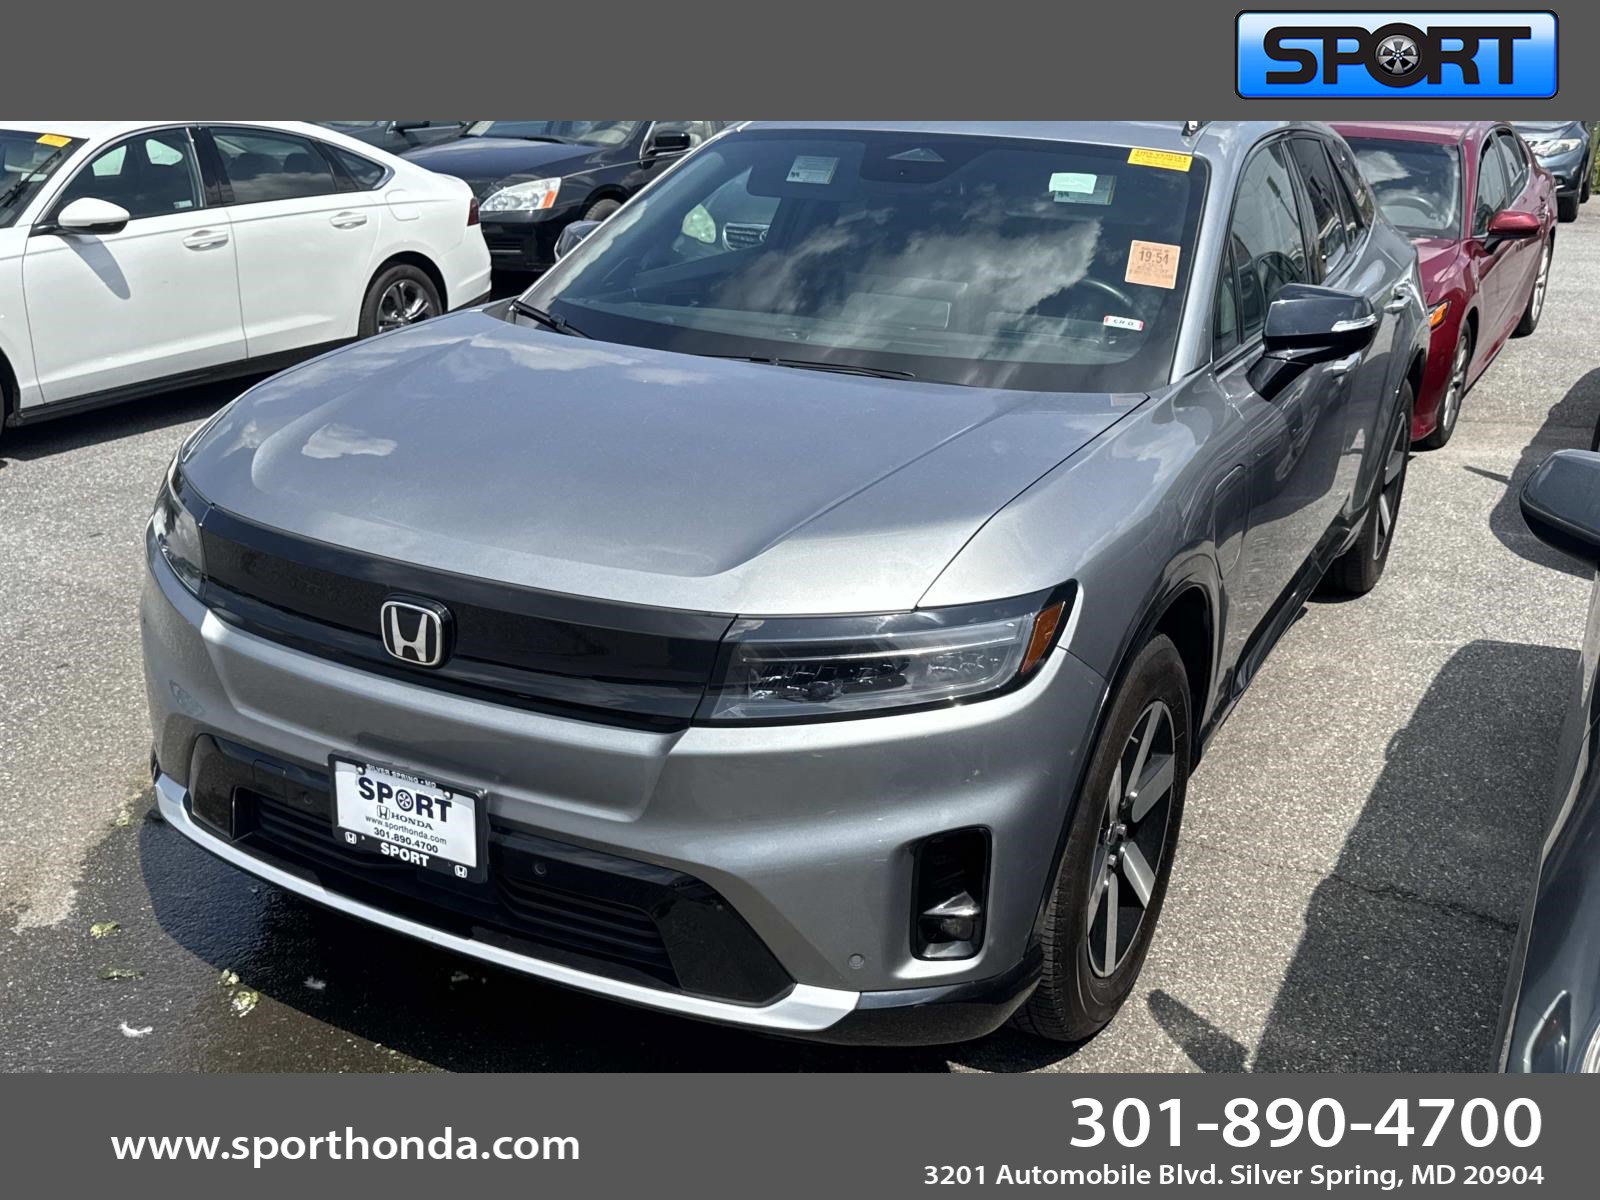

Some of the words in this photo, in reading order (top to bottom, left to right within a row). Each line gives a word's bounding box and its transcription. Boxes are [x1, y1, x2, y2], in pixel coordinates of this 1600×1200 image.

[358, 777, 453, 823] SPORT
[365, 815, 447, 846] www.sporthonda.com
[391, 812, 435, 831] HONDA
[373, 827, 439, 853] 301.890.4700
[380, 841, 430, 867] SPORT
